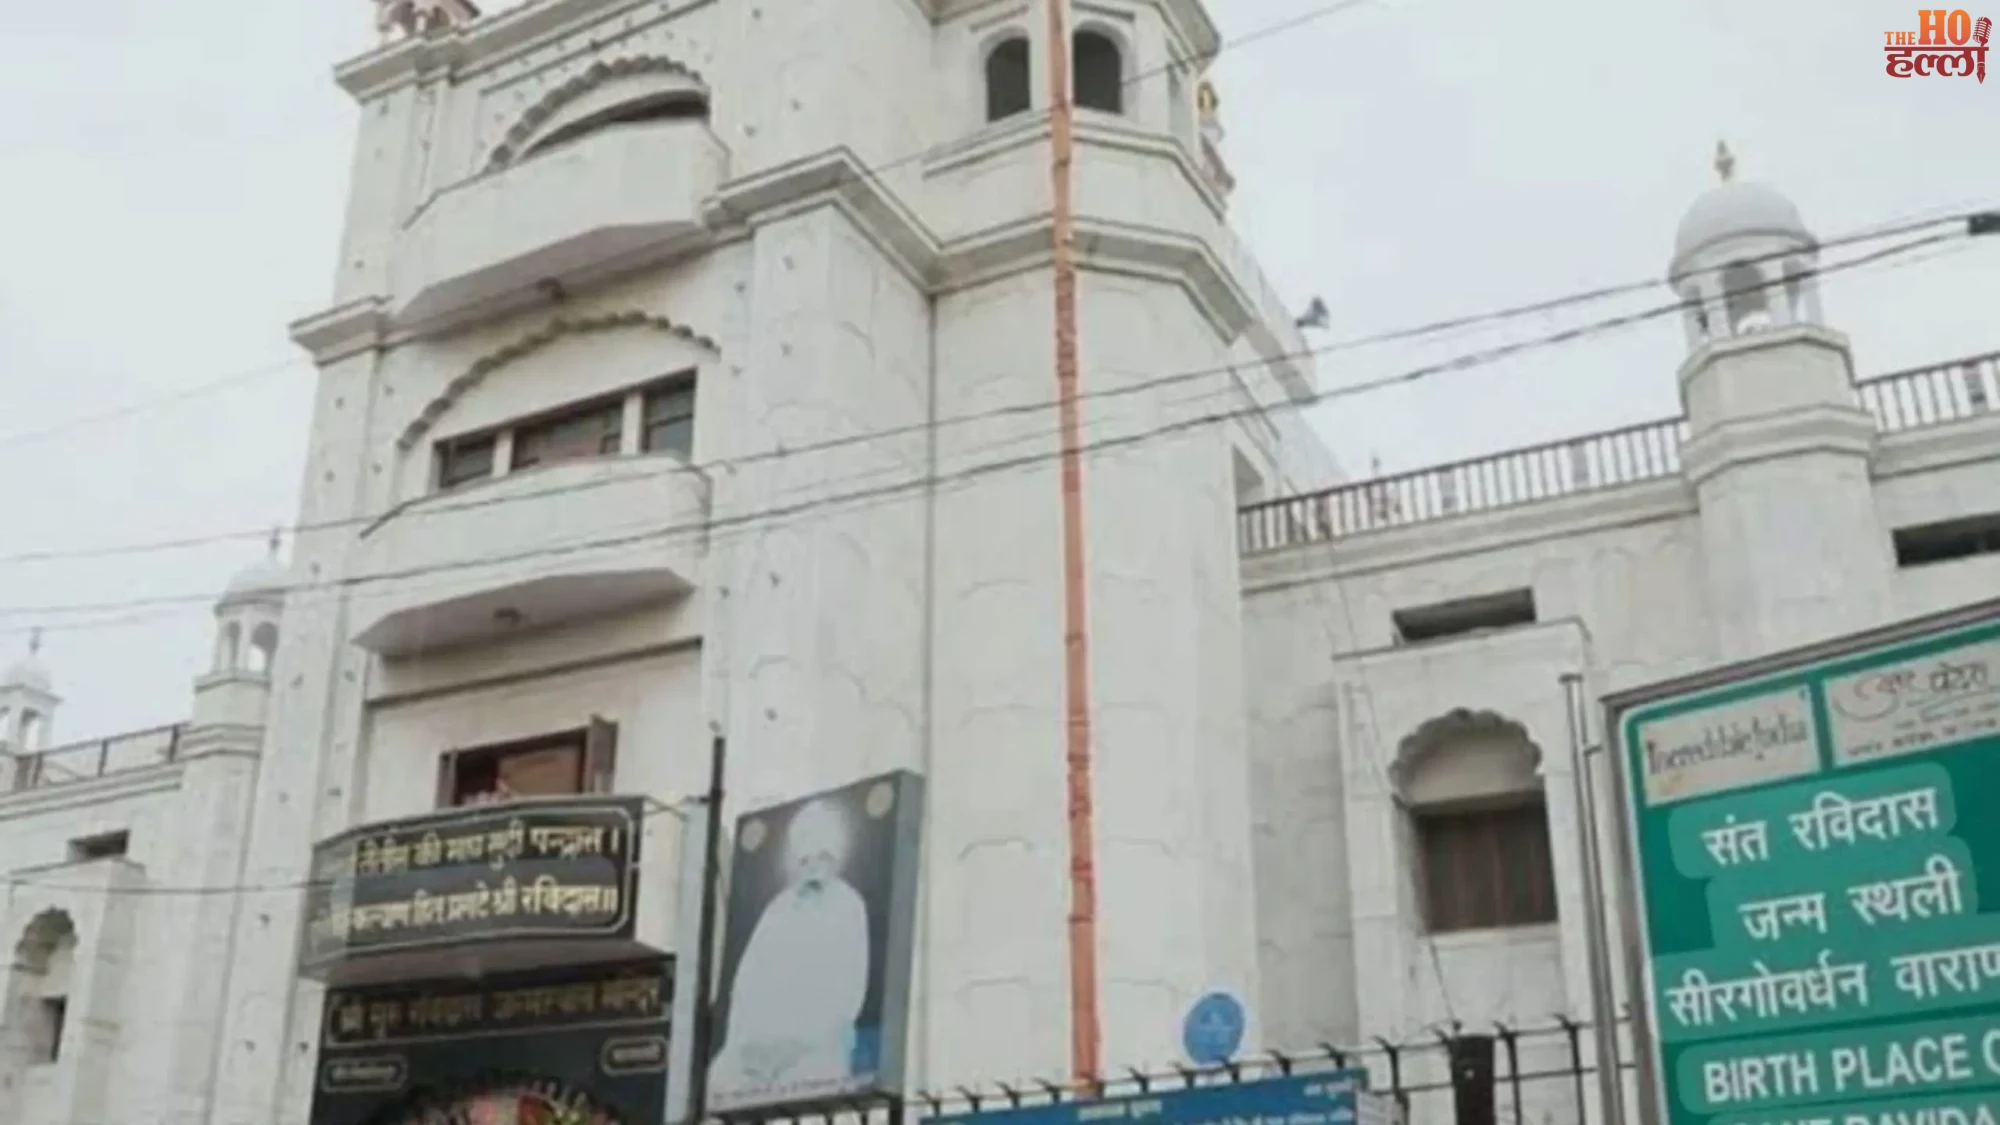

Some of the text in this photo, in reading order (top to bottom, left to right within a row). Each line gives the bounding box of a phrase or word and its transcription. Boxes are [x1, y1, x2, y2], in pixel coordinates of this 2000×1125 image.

[1701, 787, 1940, 866] संत रविदास
[1738, 853, 1964, 941] जन्म स्थली
[1664, 948, 1869, 1026] सीरगोवर्धन
[1703, 1050, 1819, 1103] BIRTH
[1831, 1033, 1974, 1092] PLACE
